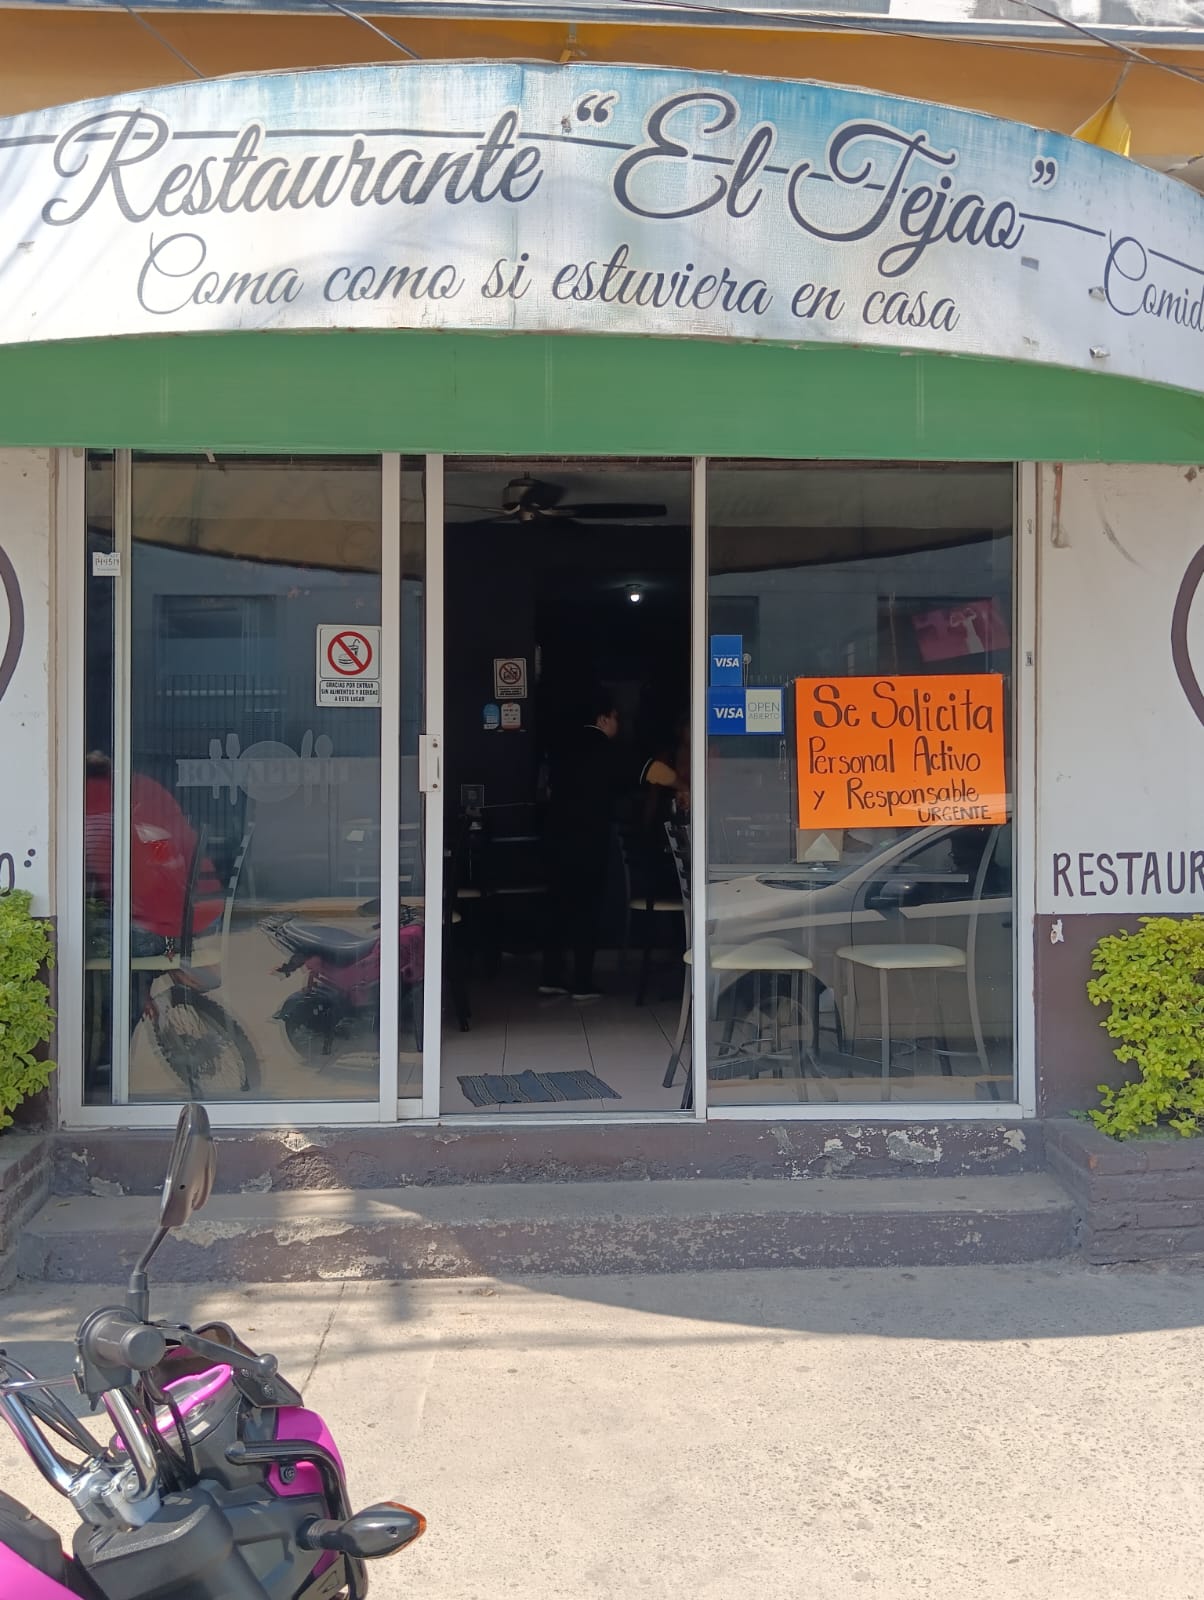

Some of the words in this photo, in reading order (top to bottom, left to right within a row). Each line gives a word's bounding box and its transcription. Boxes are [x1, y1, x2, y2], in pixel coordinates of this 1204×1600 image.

[42, 107, 544, 226] Restaurante
[137, 232, 303, 314] Coma
[323, 261, 466, 301] como
[481, 252, 533, 299] si
[552, 243, 773, 315] estuviera
[790, 281, 846, 321] en
[861, 288, 961, 332] casa
[713, 657, 740, 668] VISA
[712, 707, 744, 719] VISA
[747, 702, 780, 712] OPEN
[747, 712, 780, 720] ABIERTO
[813, 684, 860, 728] Se
[871, 681, 993, 733] Solicita
[809, 736, 895, 774] Personal
[914, 735, 981, 776] Activo
[847, 777, 979, 816] Responsable
[918, 805, 992, 823] URGENTE
